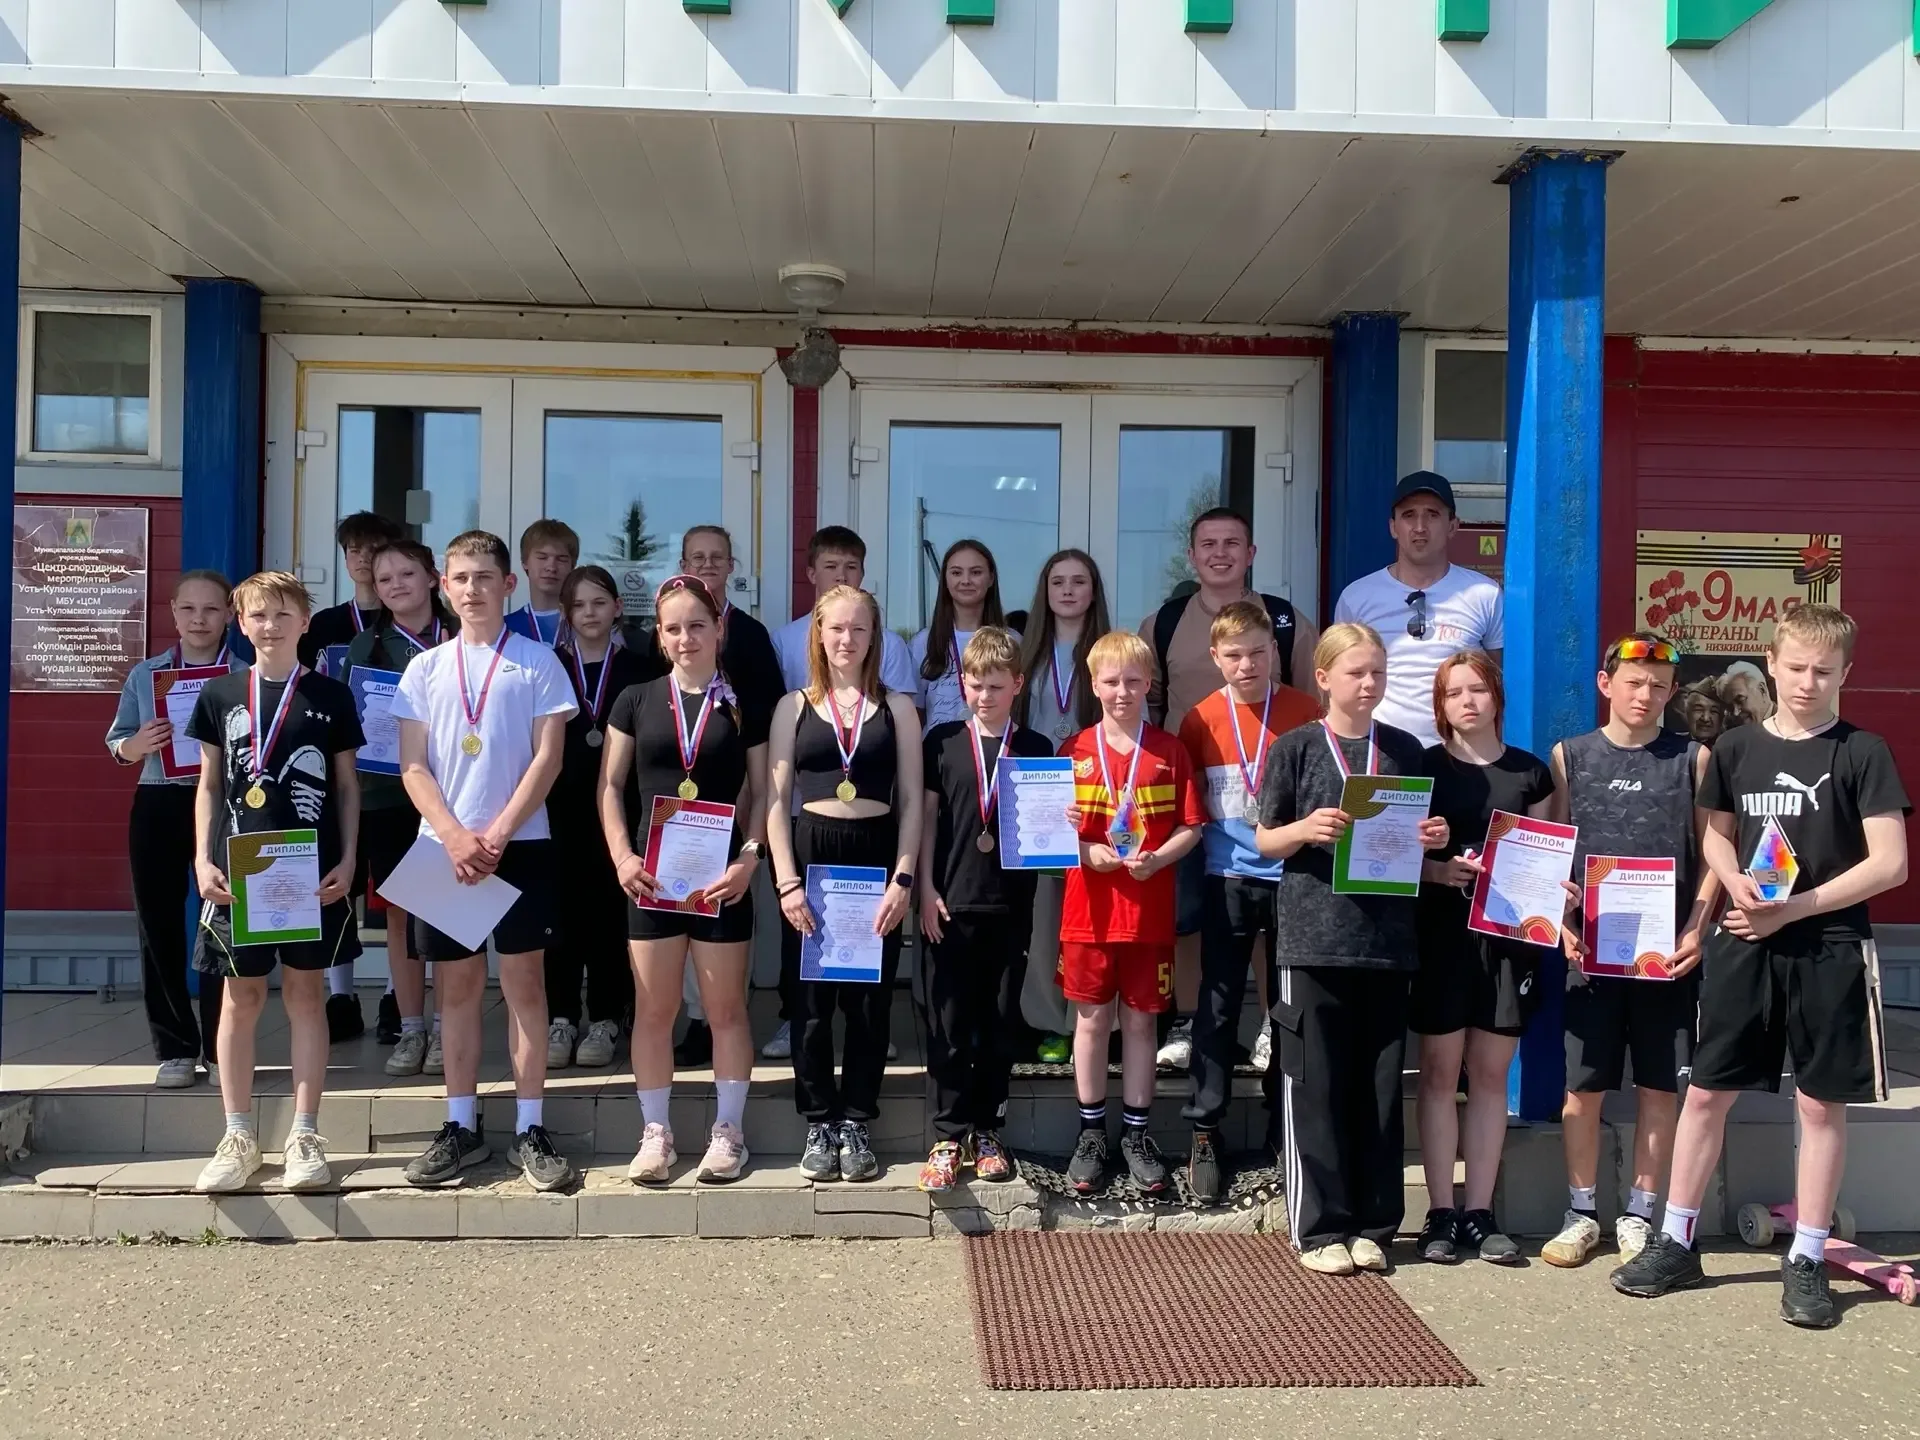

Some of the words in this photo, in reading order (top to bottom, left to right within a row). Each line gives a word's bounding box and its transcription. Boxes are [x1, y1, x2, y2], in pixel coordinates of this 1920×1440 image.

[18, 584, 98, 595] Усть-Куломского
[1702, 569, 1733, 622] 9
[56, 597, 74, 605] МБУ
[25, 606, 95, 616] Усть-Куломского
[1667, 625, 1760, 641] ВЕТЕРАНЫ
[83, 642, 122, 652] районса
[1705, 642, 1744, 652] НИЗКИЙ
[1744, 644, 1763, 652] ВАМ
[25, 654, 53, 663] спорт
[181, 681, 203, 691] ДИП
[1021, 772, 1061, 781] ДИПЛОМ
[1608, 778, 1642, 791] FILA
[1379, 791, 1425, 802] ДИПЛОМ
[682, 813, 724, 826] ДИПЛОМ
[1121, 833, 1132, 845] 2
[1518, 832, 1565, 848] ДИПЛОМ
[266, 844, 311, 854] ДИПЛОМ
[1619, 872, 1666, 882] ДИПЛОМ
[1767, 871, 1779, 884] 3
[832, 881, 873, 890] ДИПЛОМ
